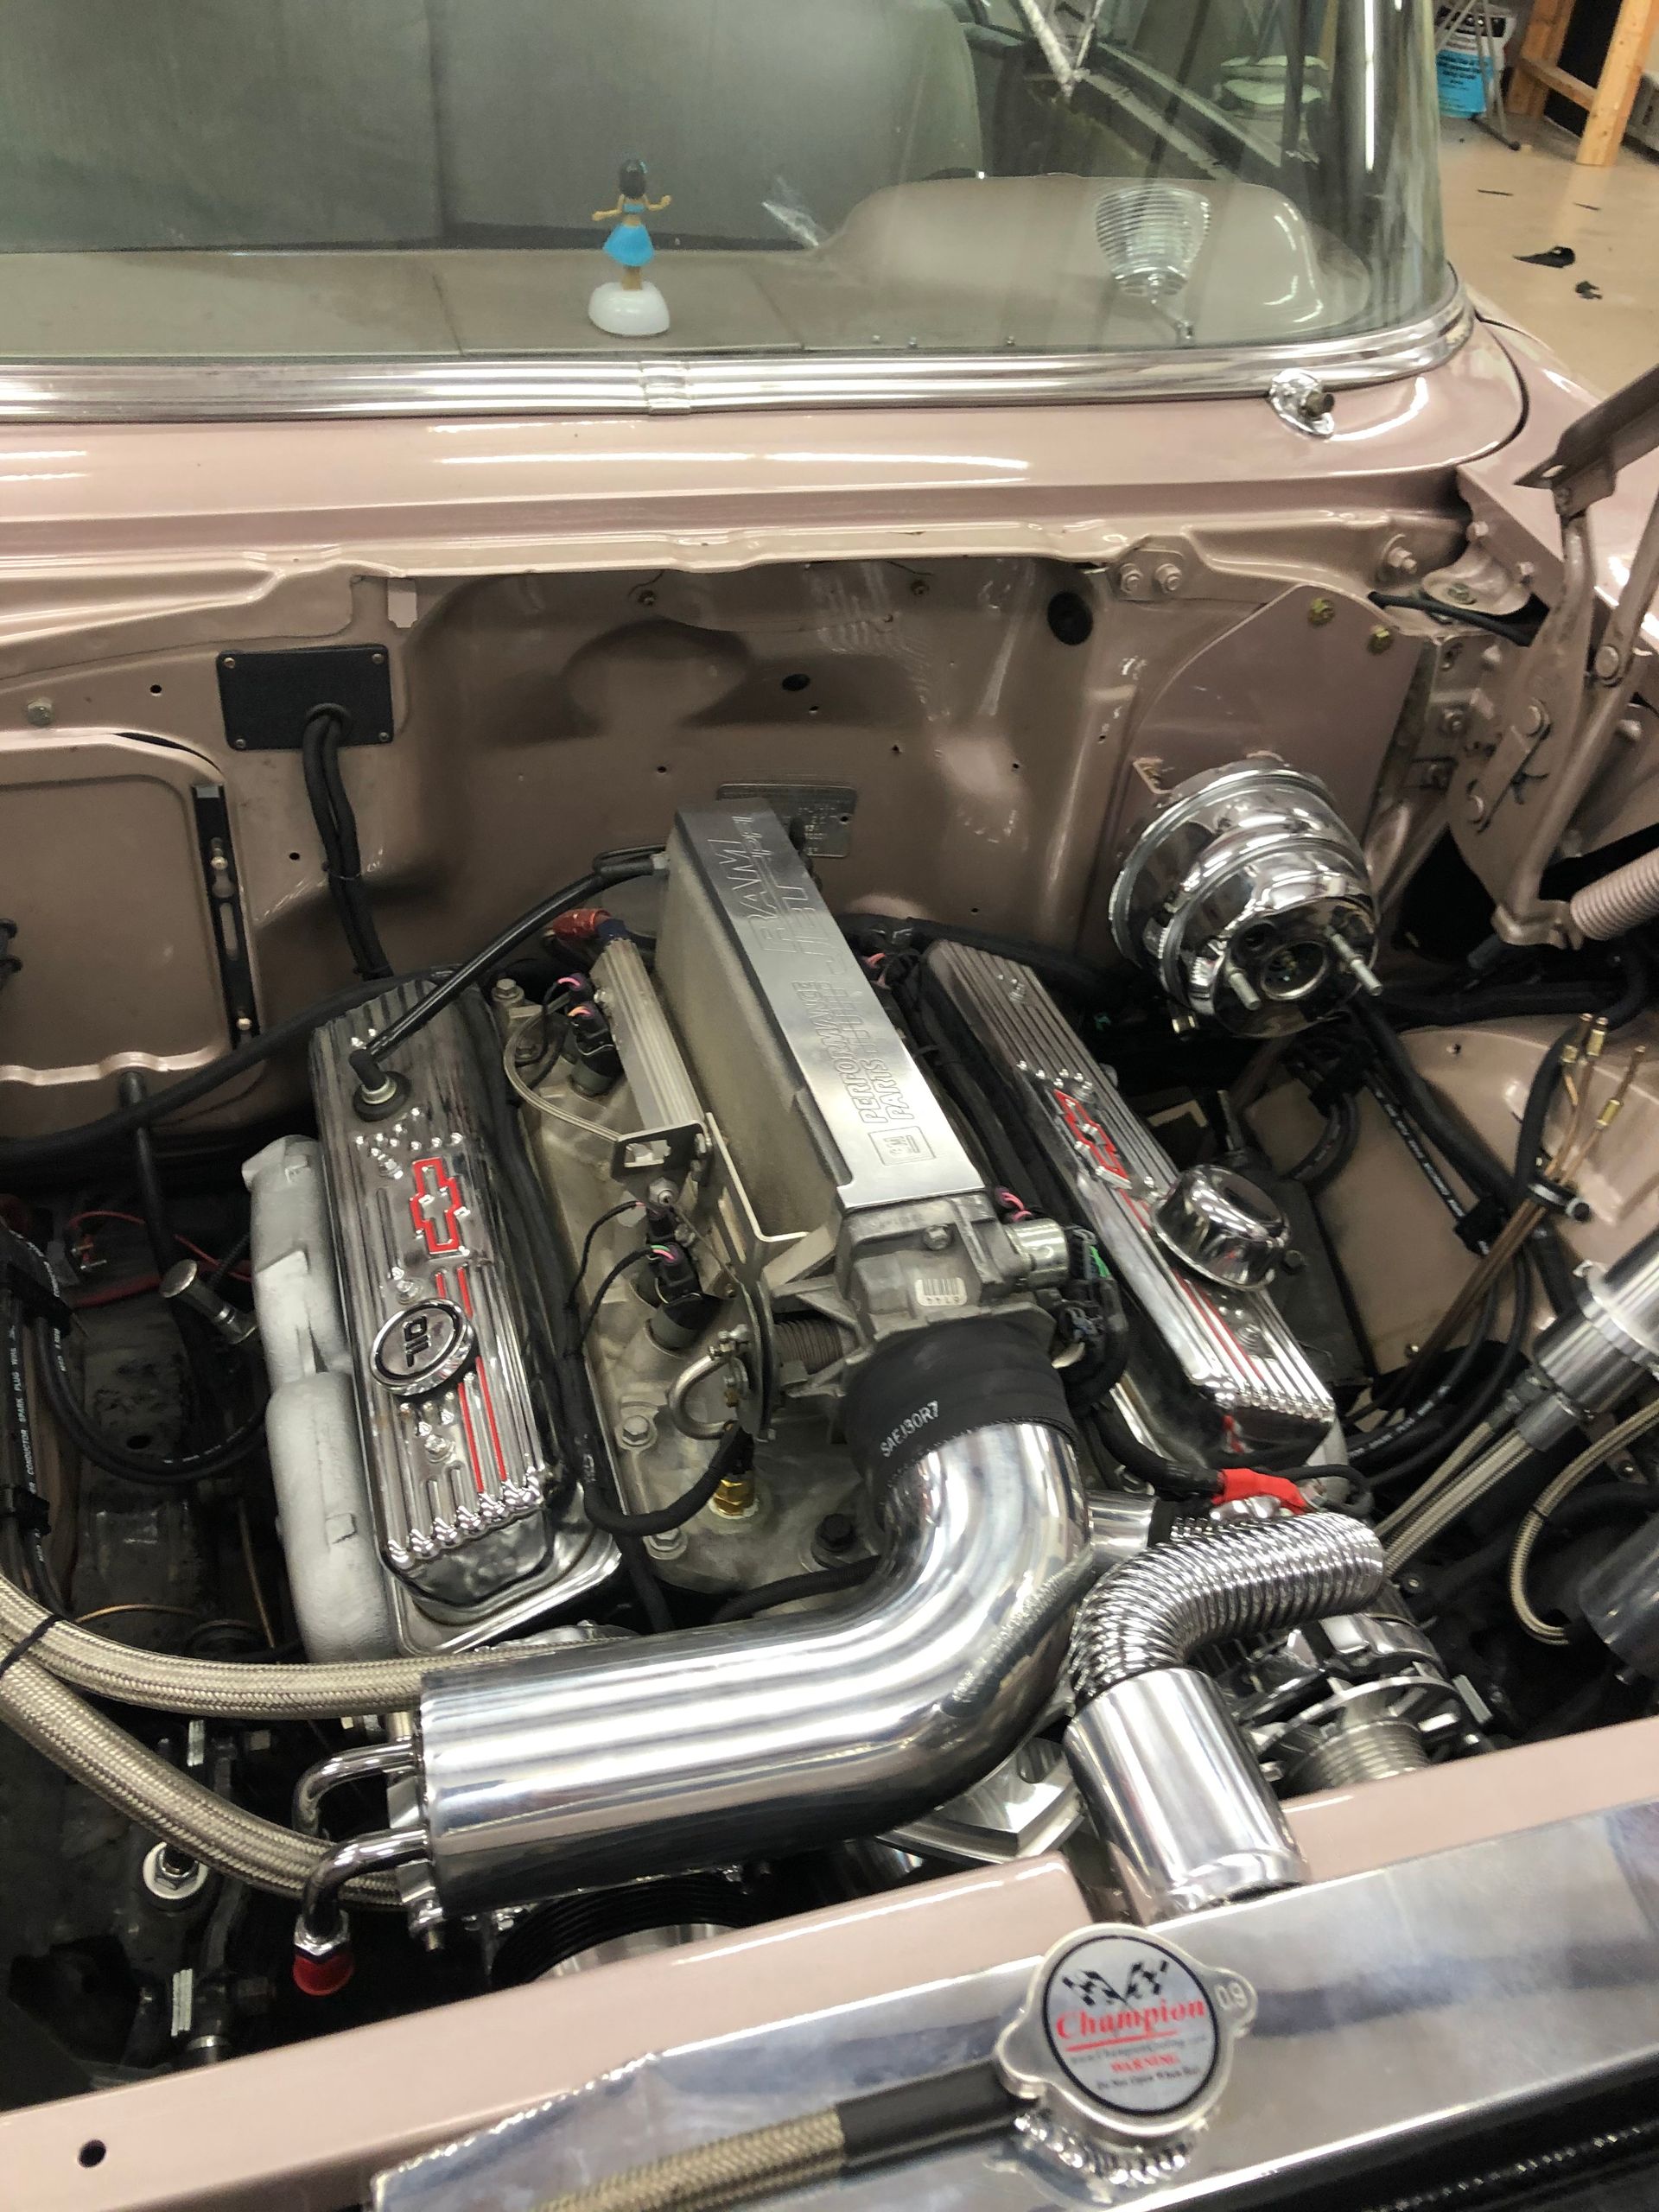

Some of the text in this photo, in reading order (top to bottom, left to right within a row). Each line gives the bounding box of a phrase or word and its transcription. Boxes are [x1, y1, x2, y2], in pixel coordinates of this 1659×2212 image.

[708, 839, 797, 952] RAM
[775, 885, 848, 975] JET
[791, 980, 888, 1123] PERFORMANCE
[861, 1058, 915, 1120] PARTS
[11, 1371, 22, 1391] PLUG
[16, 1398, 27, 1422] SPARK
[20, 1429, 35, 1475] CONDUCTOR
[1056, 1998, 1205, 2040] Champion
